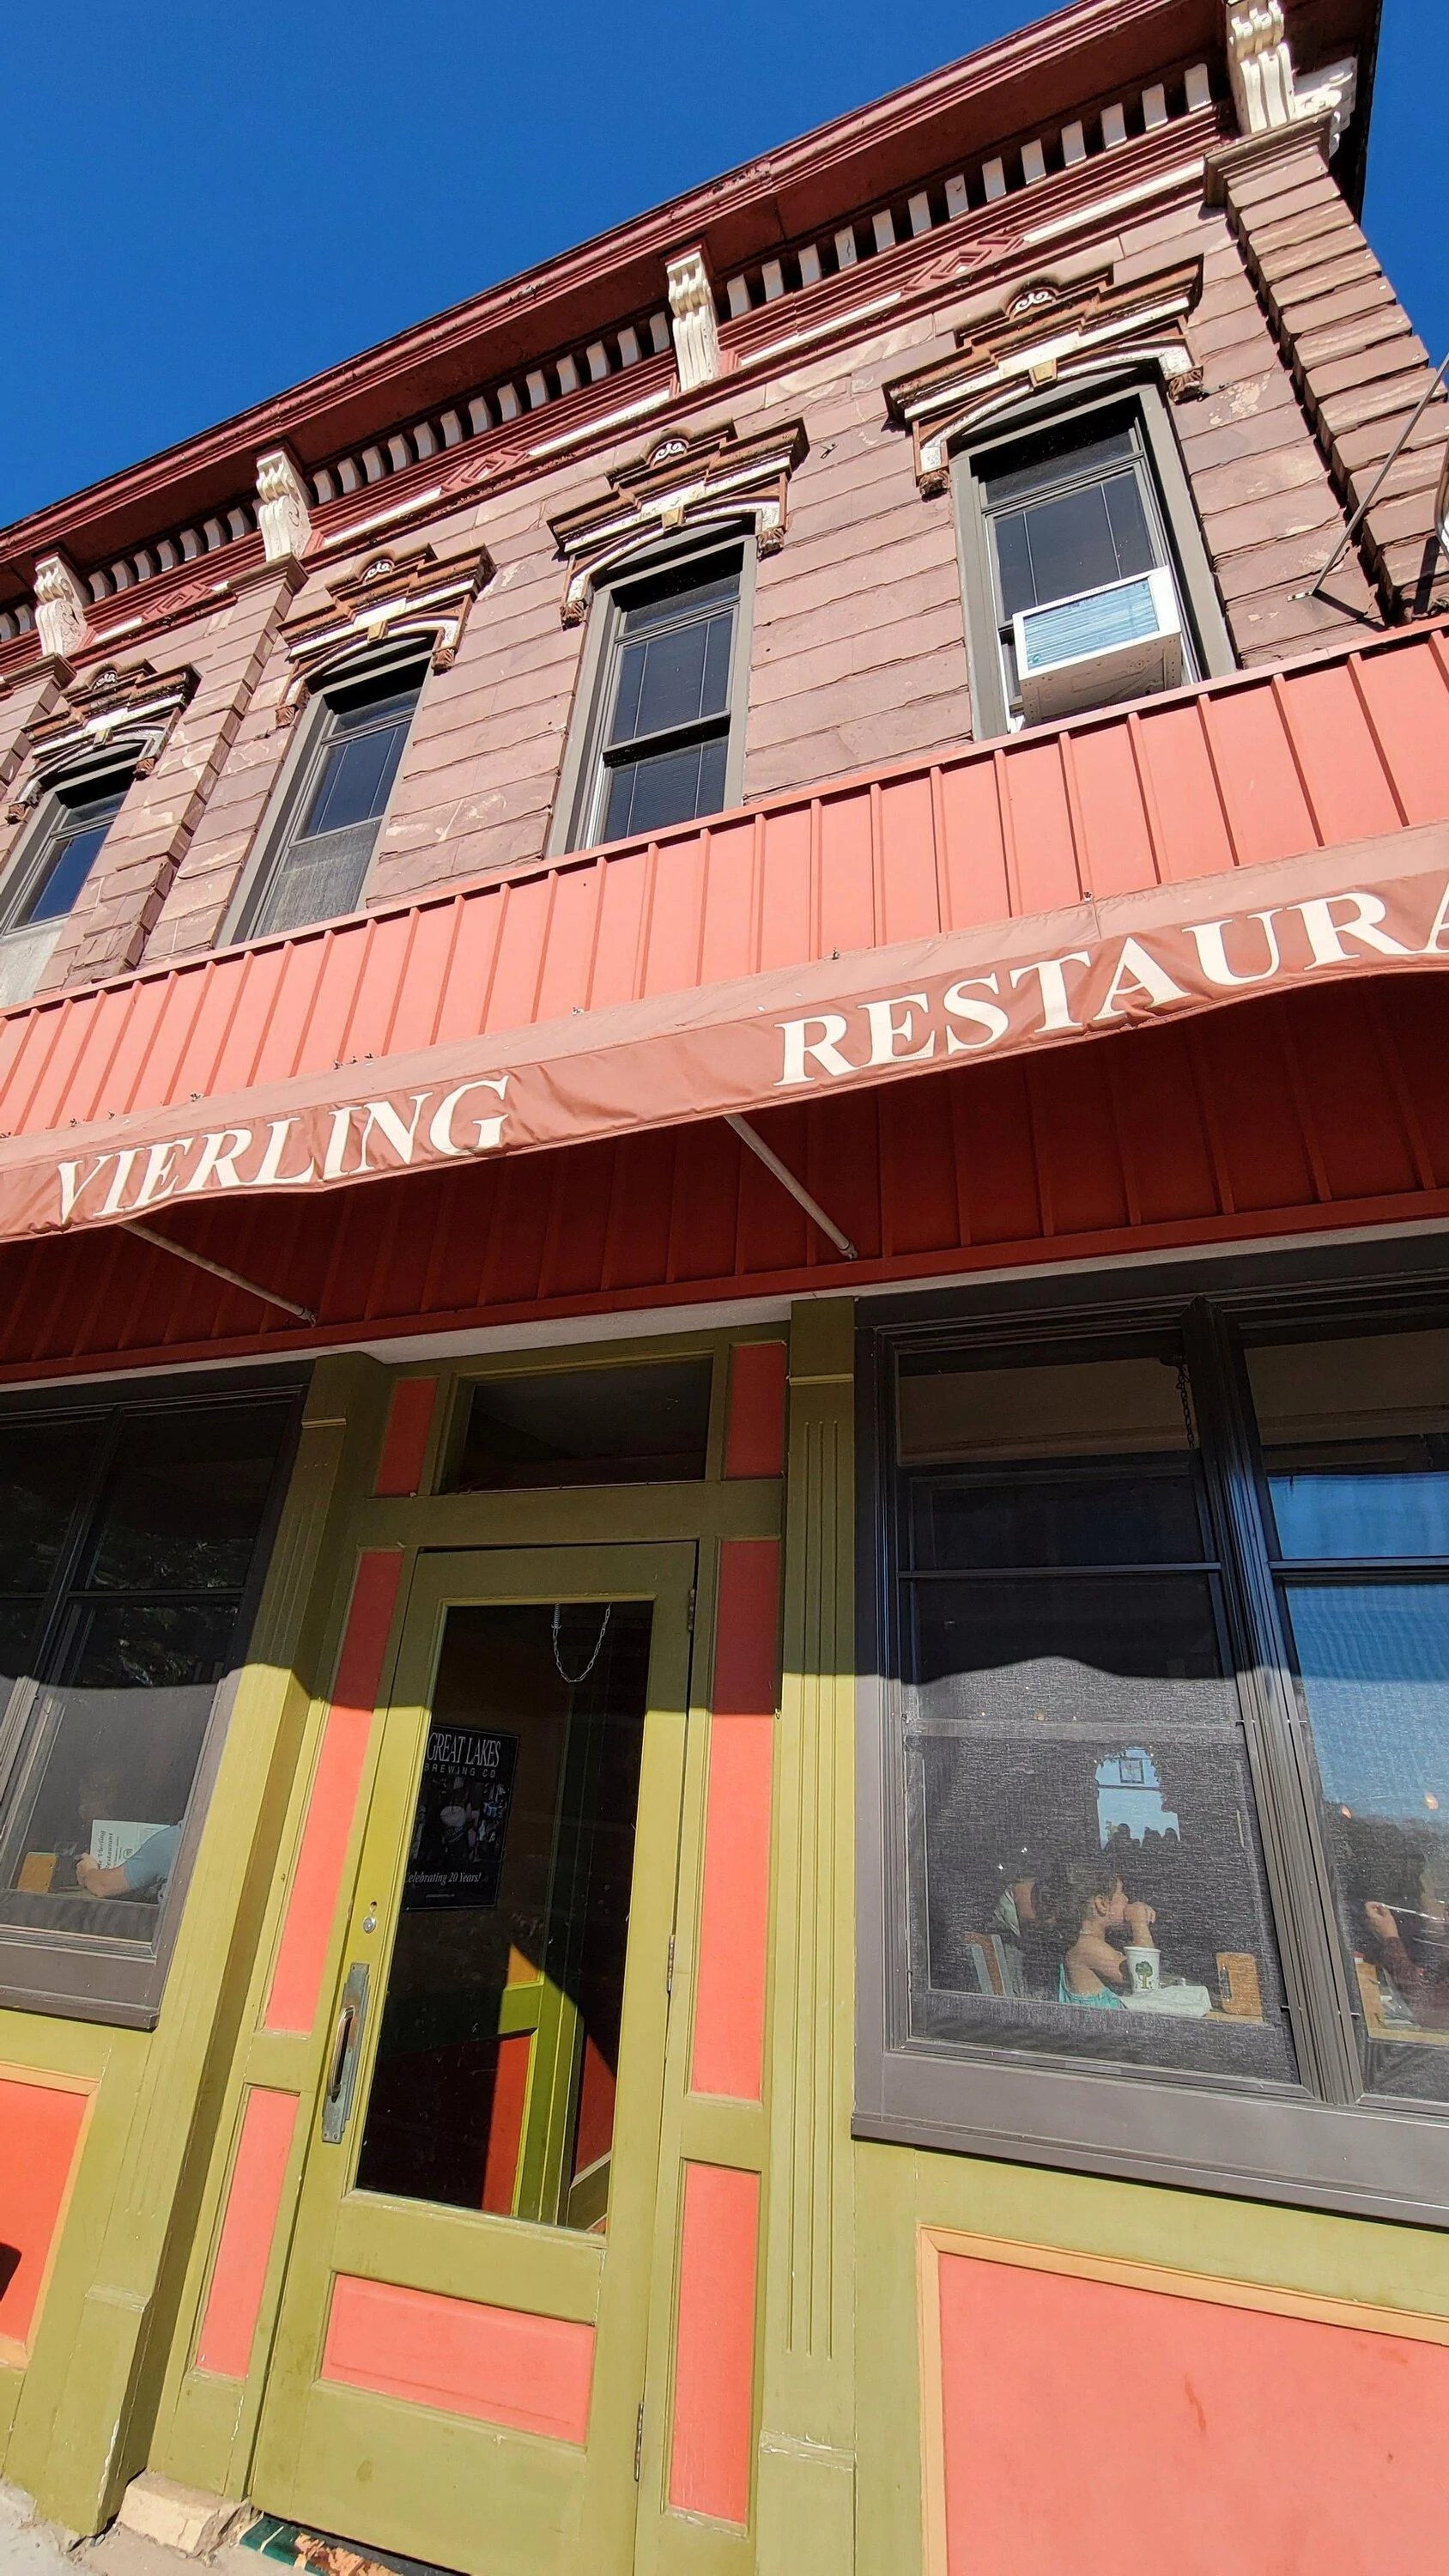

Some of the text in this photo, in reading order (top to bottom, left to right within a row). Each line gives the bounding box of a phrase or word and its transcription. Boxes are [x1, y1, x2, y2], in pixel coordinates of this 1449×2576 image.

[57, 1074, 510, 1225] VIERLING
[426, 1732, 501, 1768] GREAT LAKES
[424, 1763, 476, 1777] BREWING
[447, 1872, 458, 1883] 20
[458, 1872, 482, 1883] Years!
